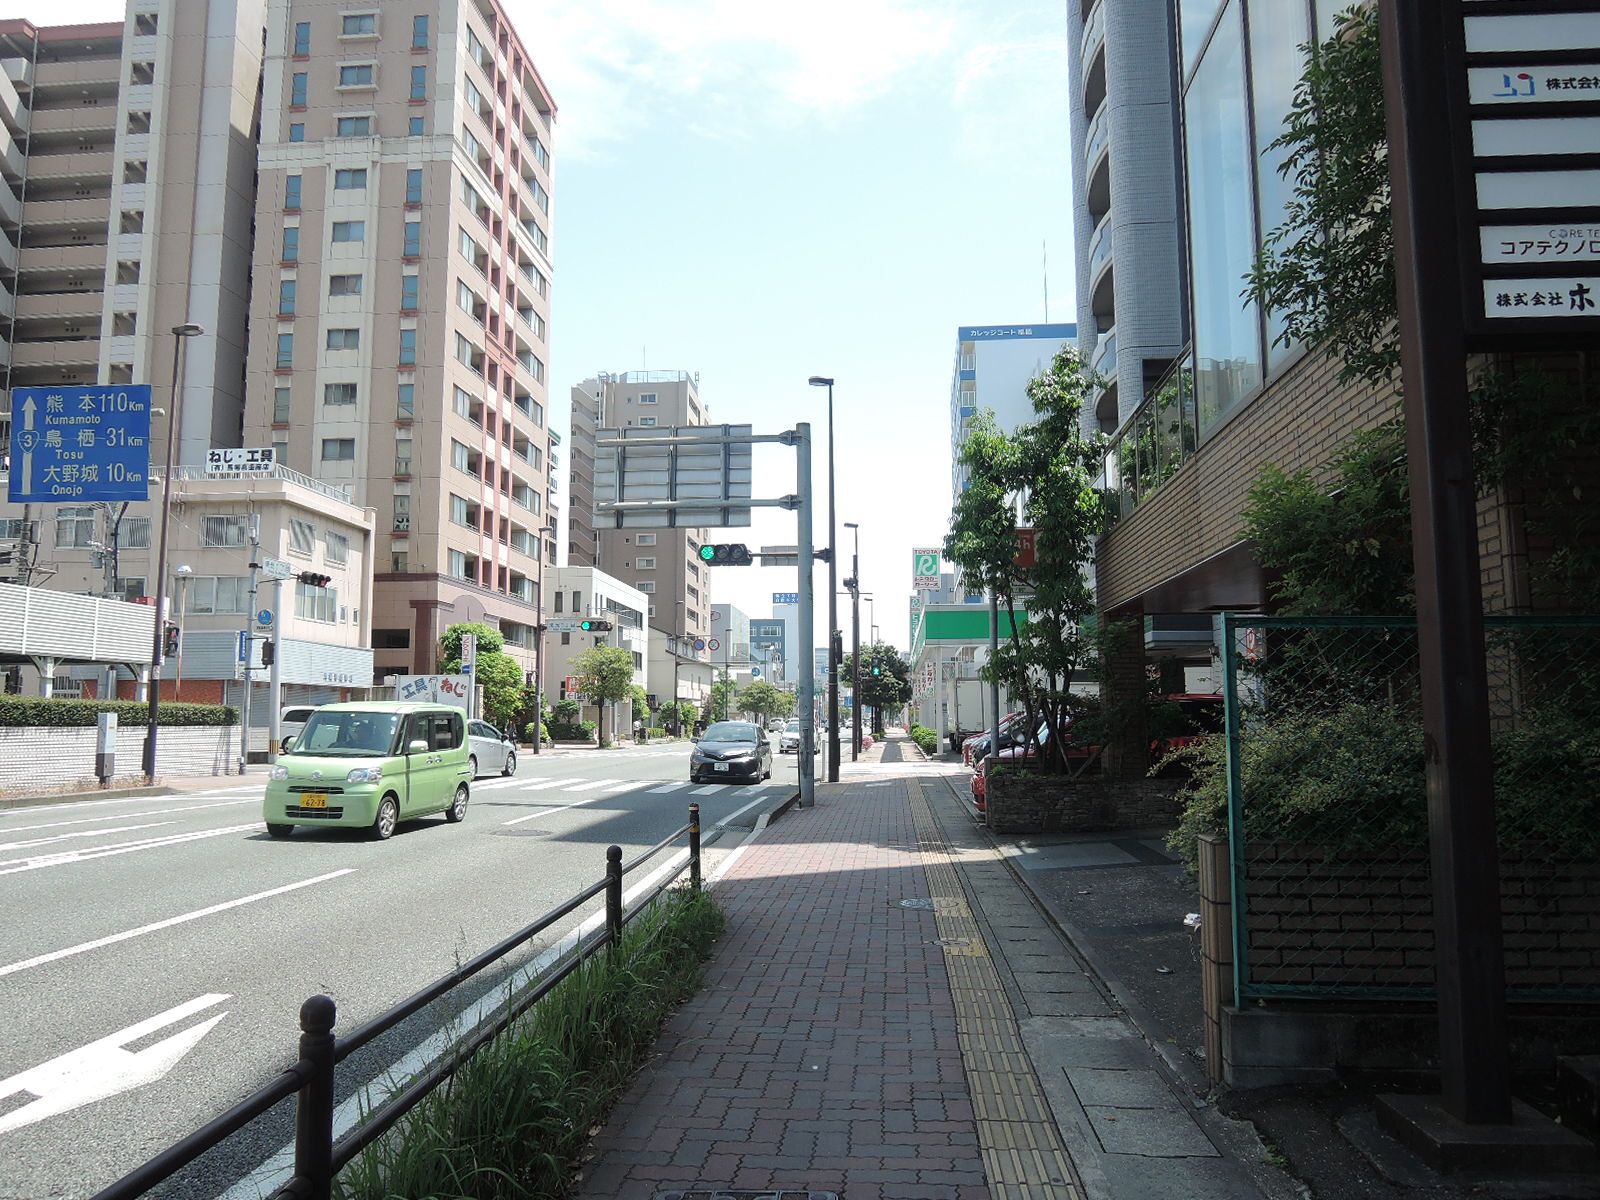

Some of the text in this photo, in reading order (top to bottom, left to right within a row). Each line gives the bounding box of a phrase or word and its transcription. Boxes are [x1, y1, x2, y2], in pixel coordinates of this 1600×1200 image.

[45, 393, 96, 413] 熊本
[45, 414, 101, 425] Kumamoto
[24, 434, 32, 447] 3
[44, 429, 95, 448] 鳥栖
[55, 449, 84, 460] Tosu
[43, 464, 99, 483] 大野城
[51, 485, 83, 497] Onojo
[401, 677, 467, 700] 工具 ねじ
